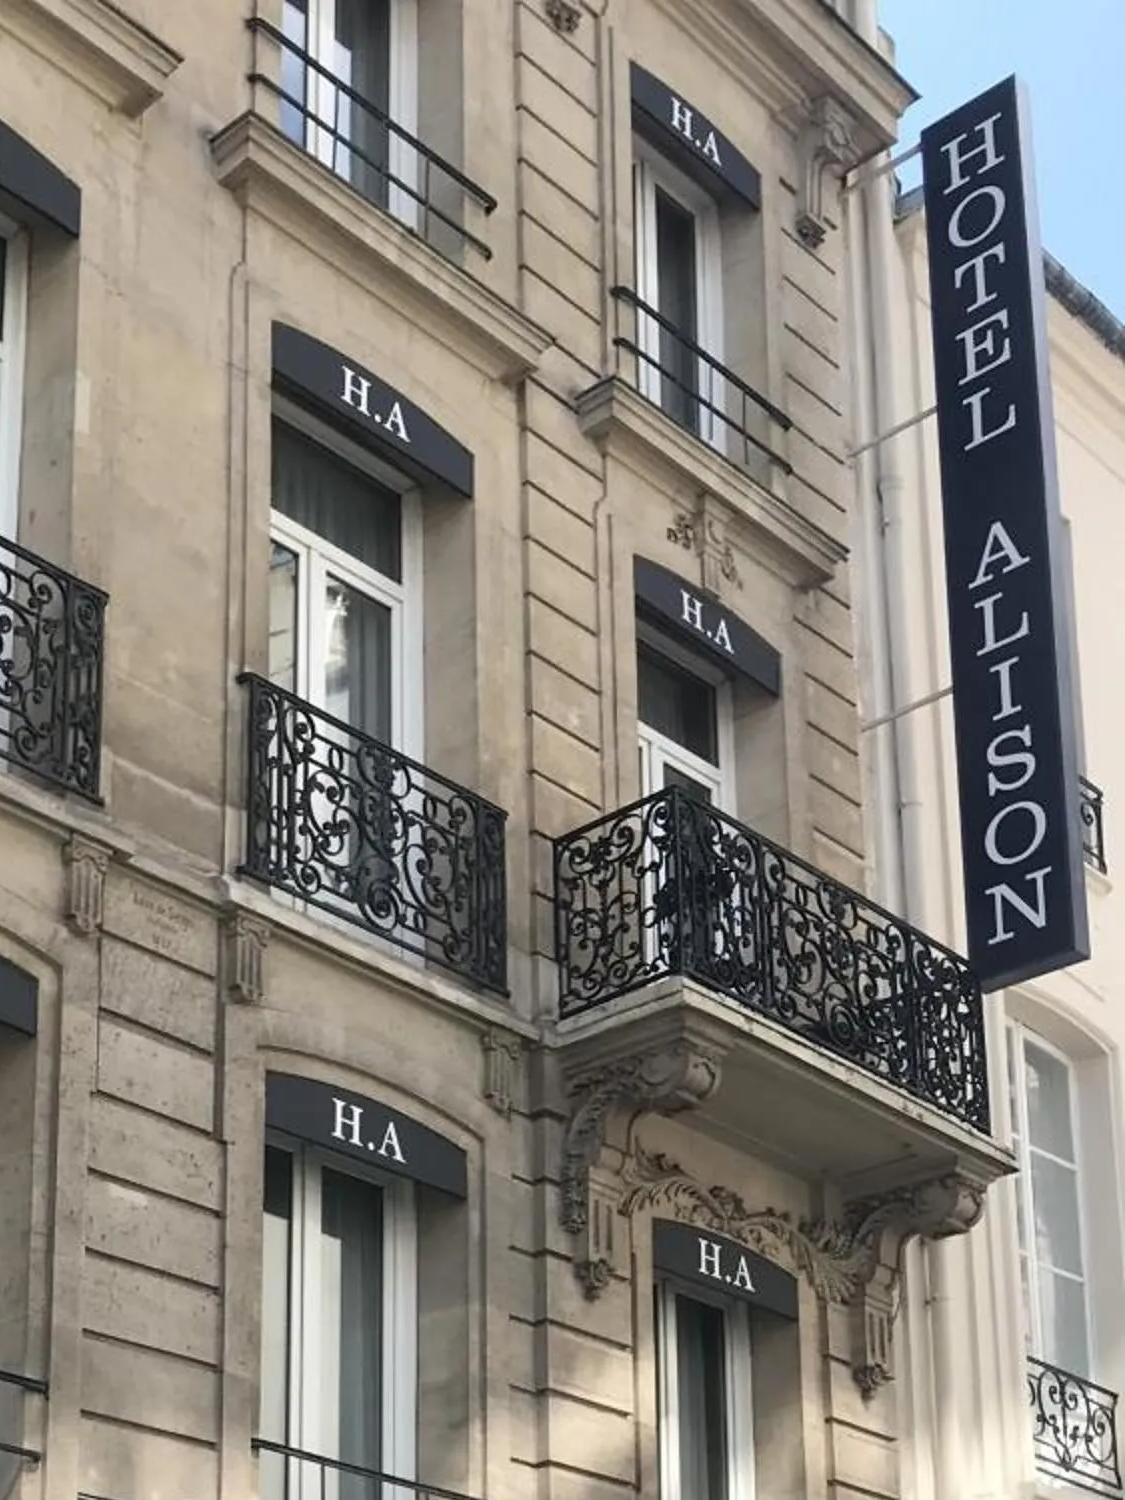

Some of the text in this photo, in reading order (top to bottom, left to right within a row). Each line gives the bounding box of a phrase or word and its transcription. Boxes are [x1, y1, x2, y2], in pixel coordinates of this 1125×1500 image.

[671, 97, 722, 166] H.A
[340, 365, 411, 443] H.A
[940, 112, 1052, 945] HOTEL ALISON
[680, 589, 735, 654] H.A
[331, 1097, 406, 1163] H.A
[698, 1237, 755, 1292] H.A
